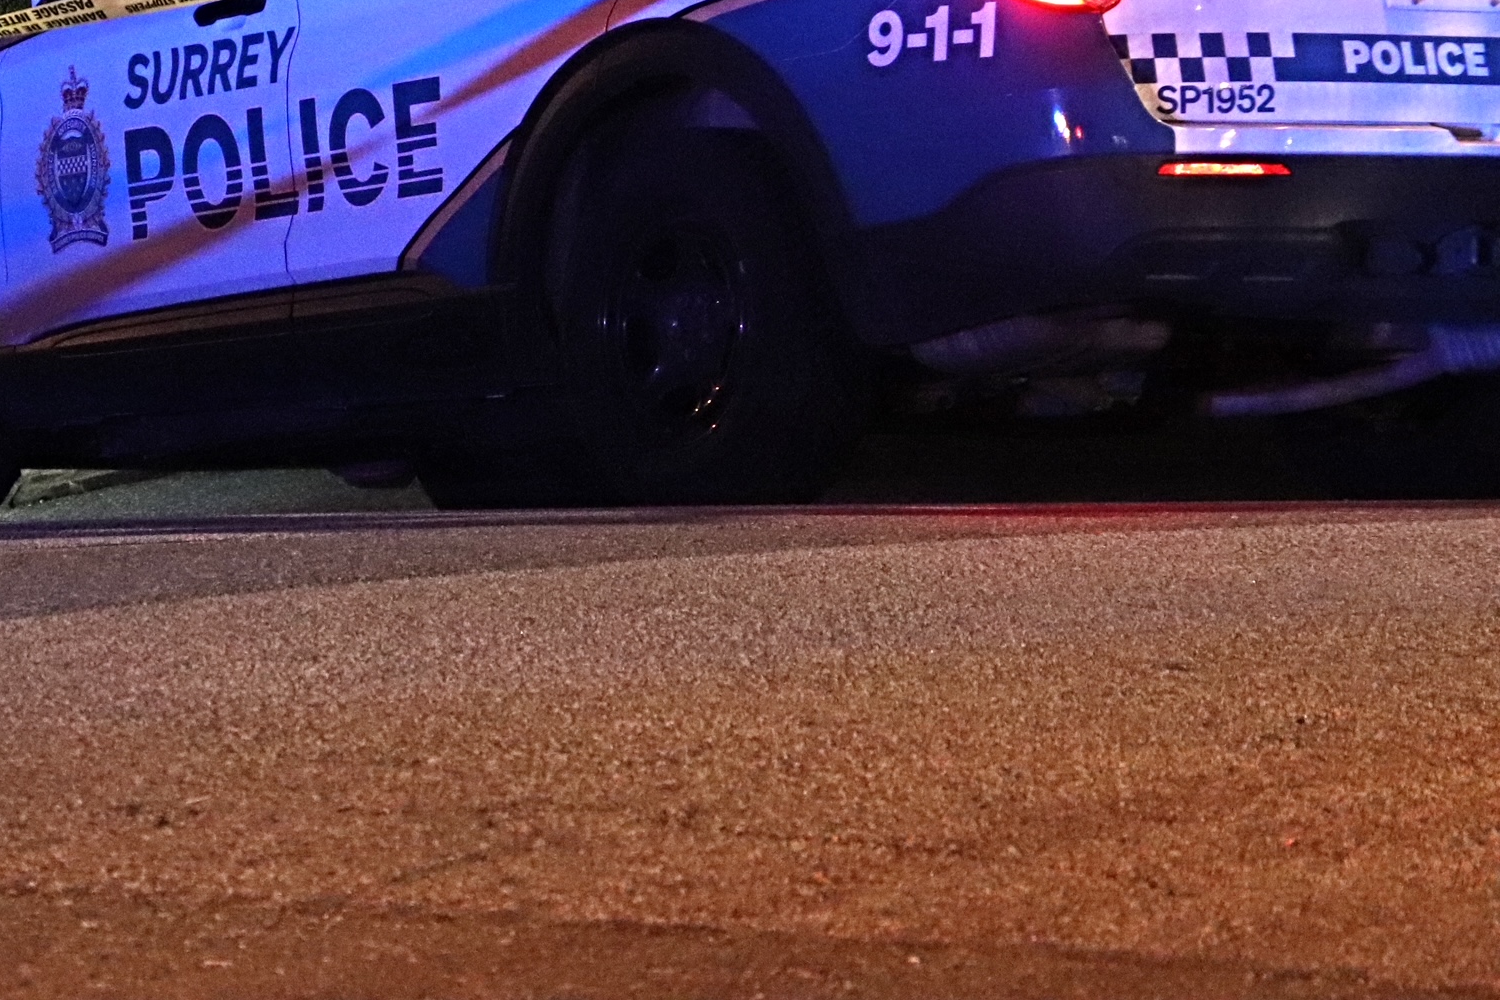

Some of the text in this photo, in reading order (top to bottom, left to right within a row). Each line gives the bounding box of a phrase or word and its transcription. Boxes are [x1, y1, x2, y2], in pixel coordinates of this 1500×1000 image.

[42, 10, 108, 29] BARRAGE
[867, 1, 997, 67] 9-1-1
[124, 26, 296, 110] SURREY
[1342, 39, 1490, 77] POLICE
[1157, 83, 1276, 115] SP1952
[124, 76, 444, 241] POLICE
